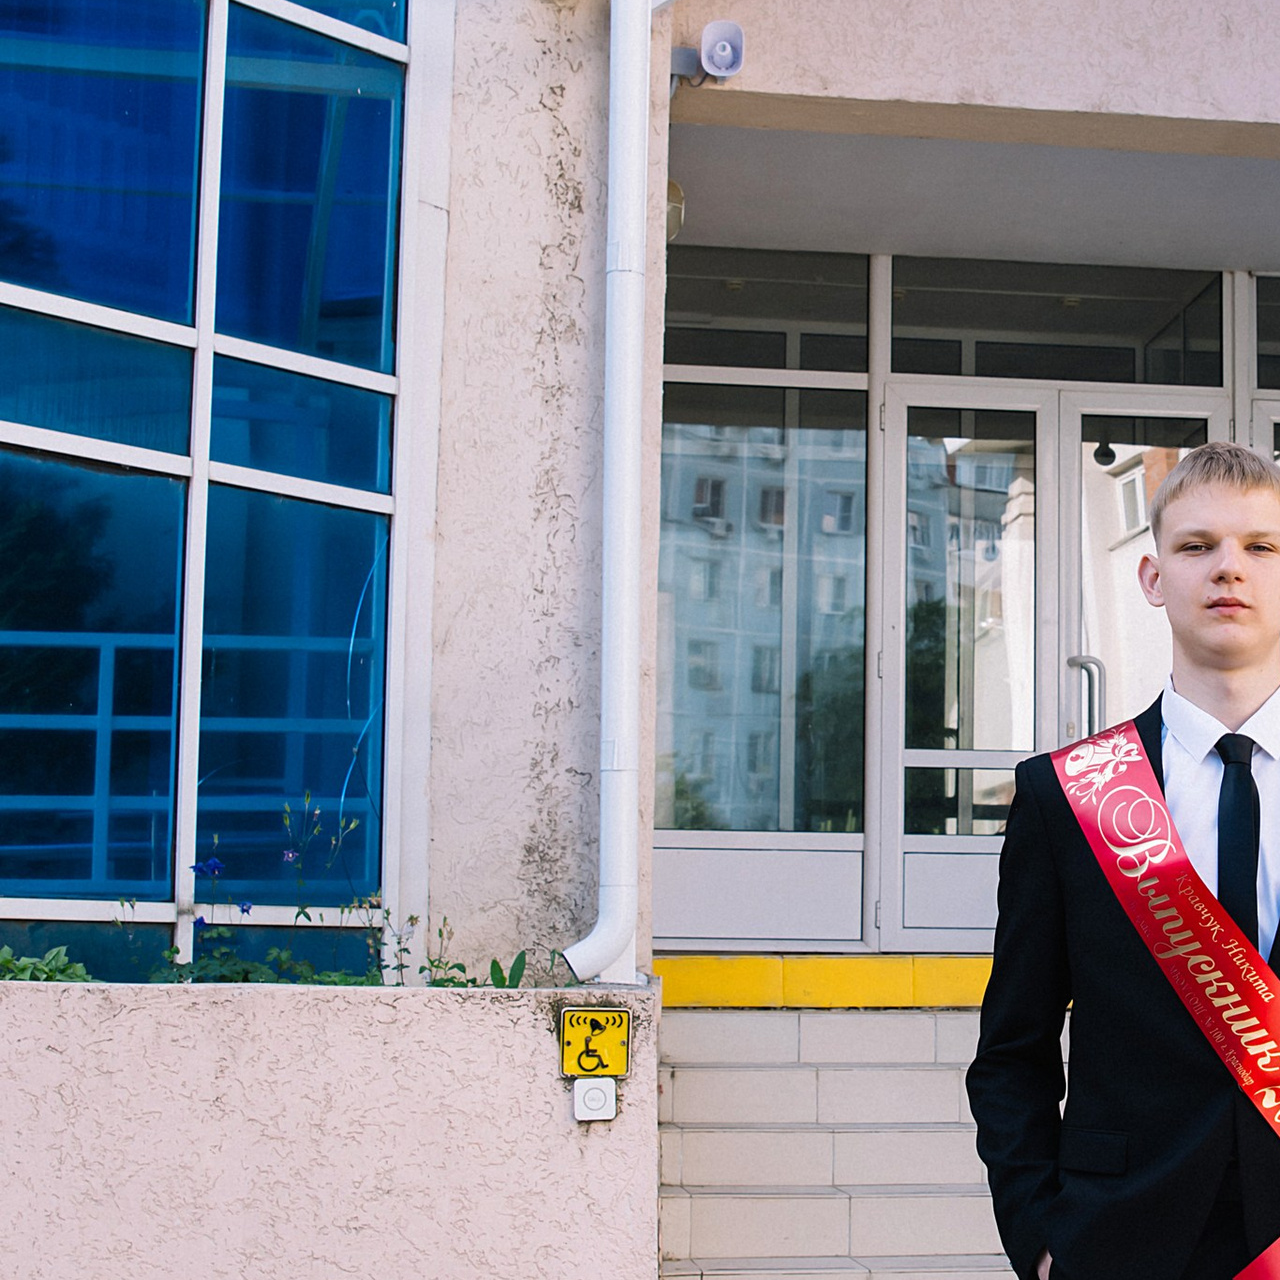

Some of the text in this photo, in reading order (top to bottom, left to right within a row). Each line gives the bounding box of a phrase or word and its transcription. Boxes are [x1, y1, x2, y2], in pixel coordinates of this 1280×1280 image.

[1176, 871, 1275, 1003] Кравчук Никита
[1209, 1027, 1226, 1044] 100
[1225, 1048, 1255, 1087] Краснодар
